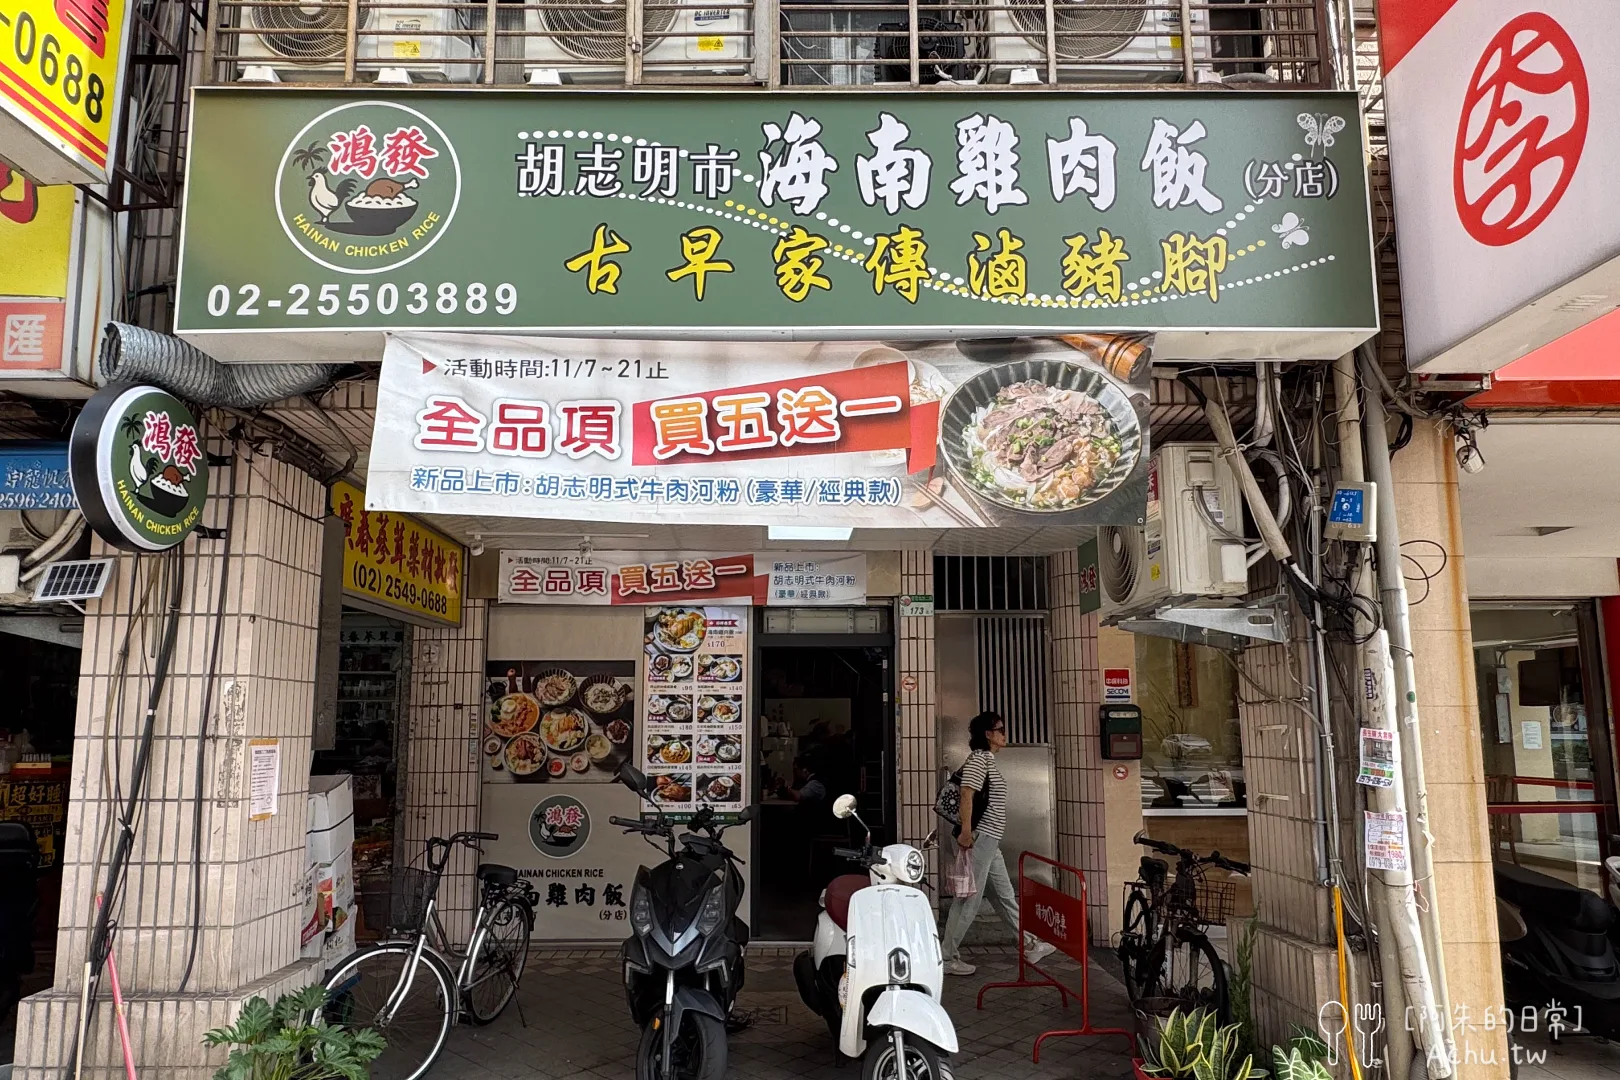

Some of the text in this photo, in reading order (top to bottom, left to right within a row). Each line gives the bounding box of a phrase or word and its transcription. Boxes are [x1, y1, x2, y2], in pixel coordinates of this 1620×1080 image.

[329, 124, 439, 179] 鴻發
[516, 112, 1338, 215] 胡志明市 海南雞肉飯 (分店)
[293, 210, 442, 258] HAINAN CHICKEN RICE
[565, 222, 1230, 304] 古早家傳滷豬腳
[207, 282, 517, 317] 02-25503889
[142, 411, 202, 476] 鴻發
[416, 389, 900, 457] 全品項 買五送一
[116, 479, 200, 535] HAINAN CHICKEN RICE
[353, 561, 447, 615] (02) 2549-0688
[510, 561, 746, 595] 全品項 買五送一
[773, 575, 856, 586] 胡志明式牛肉河粉
[910, 607, 925, 615] 173
[546, 805, 584, 826] 鴻發
[517, 869, 604, 878] AINAN CHICKEN RICE
[599, 910, 627, 921] (分店)
